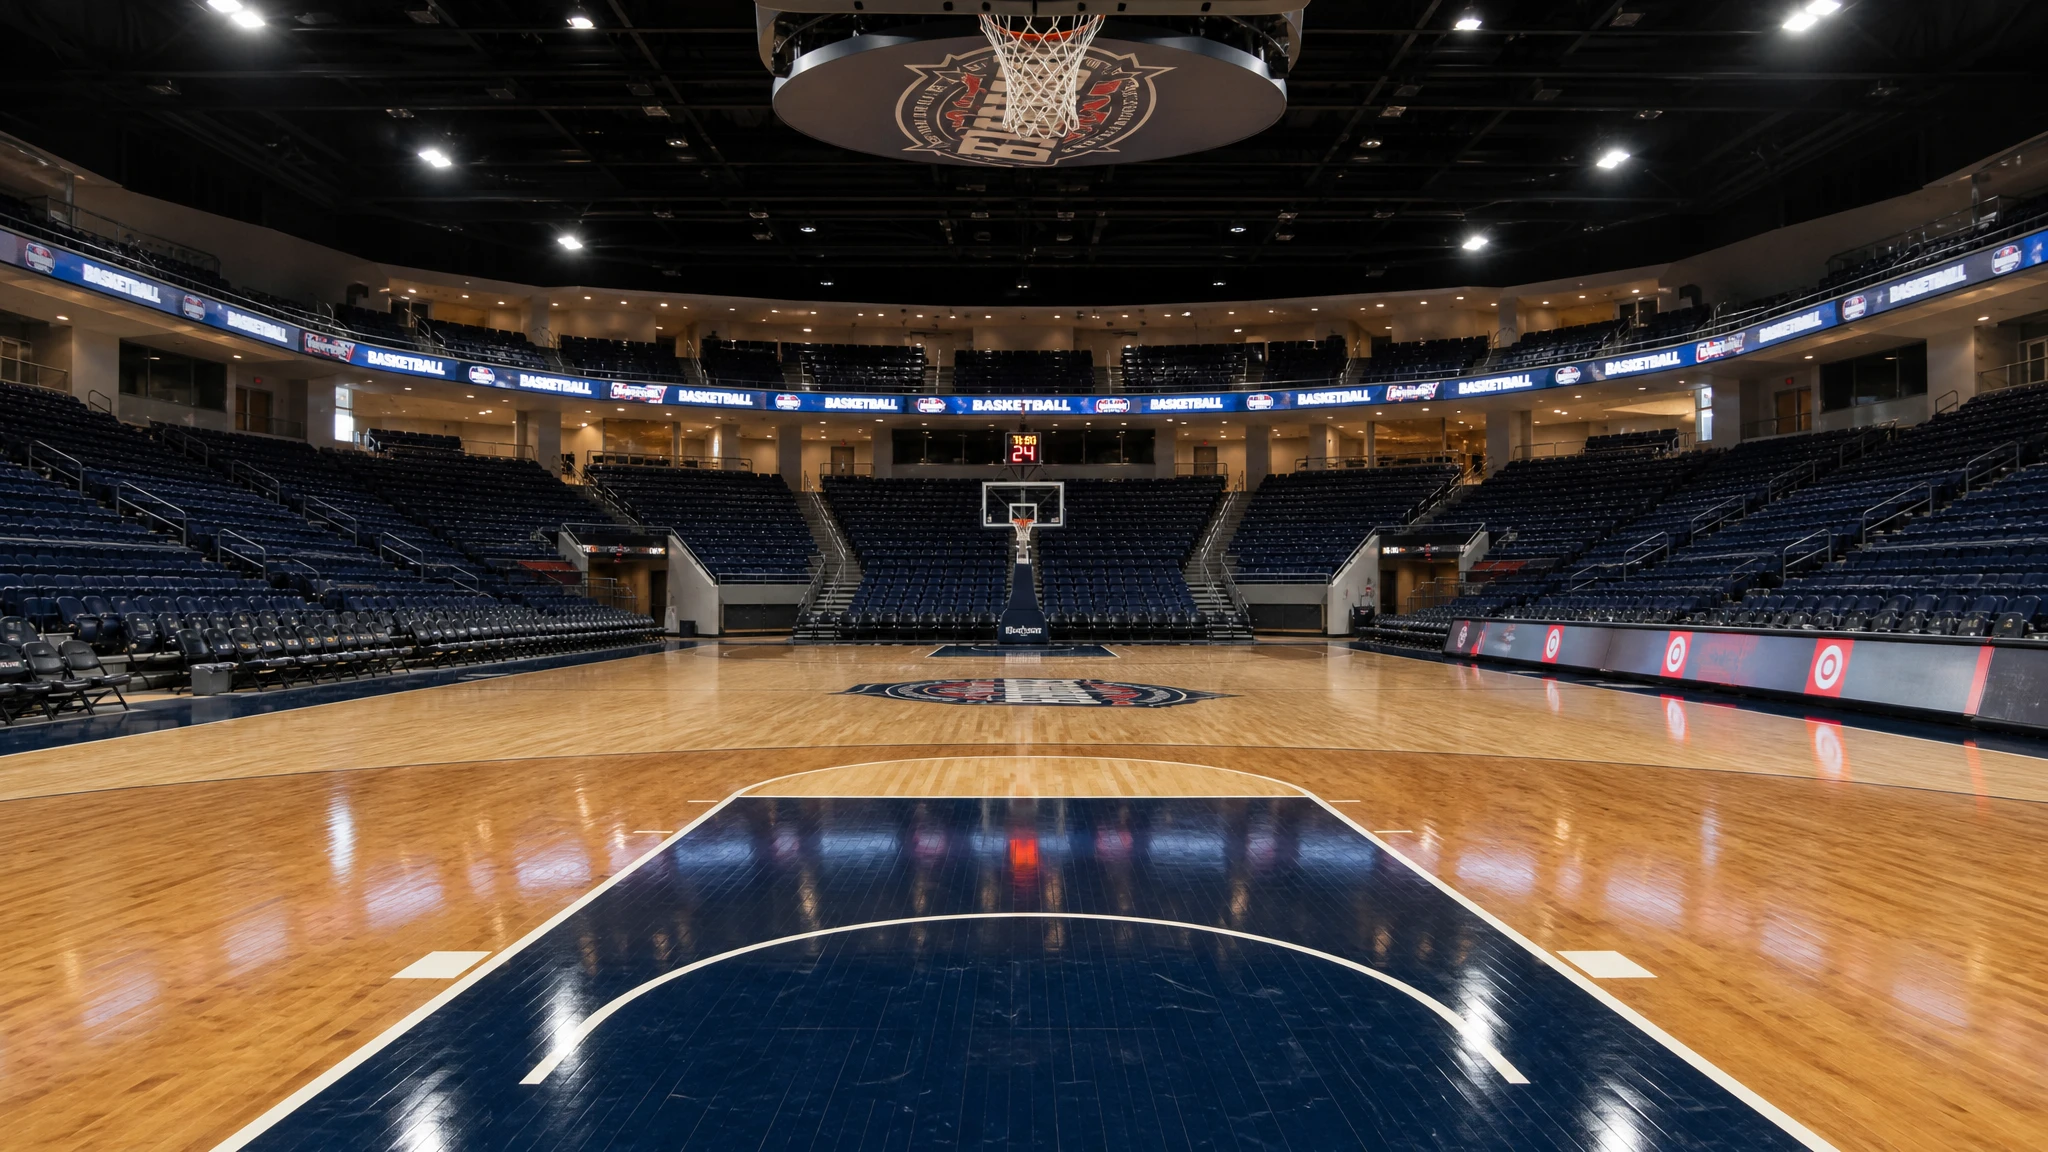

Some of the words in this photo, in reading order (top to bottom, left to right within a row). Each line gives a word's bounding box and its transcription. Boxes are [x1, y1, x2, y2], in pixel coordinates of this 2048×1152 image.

[83, 264, 161, 303] BASKETBALL
[1888, 264, 1967, 303] BASKETBALL
[227, 310, 288, 342] BASKETBALL
[1758, 311, 1823, 344] BASKETBALL
[367, 350, 446, 375] BASKETBALL
[1604, 351, 1681, 376] BASKETBALL
[519, 373, 592, 394] BASKETBALL
[1458, 374, 1533, 394] BASKETBALL
[678, 390, 753, 405] BASKETBALL
[825, 398, 898, 410] BASKETBALL
[972, 399, 1071, 411] BASKETBALL
[1150, 398, 1224, 410] BASKETBALL
[1297, 389, 1371, 405] BASKETBALL
[1012, 445, 1035, 462] 24
